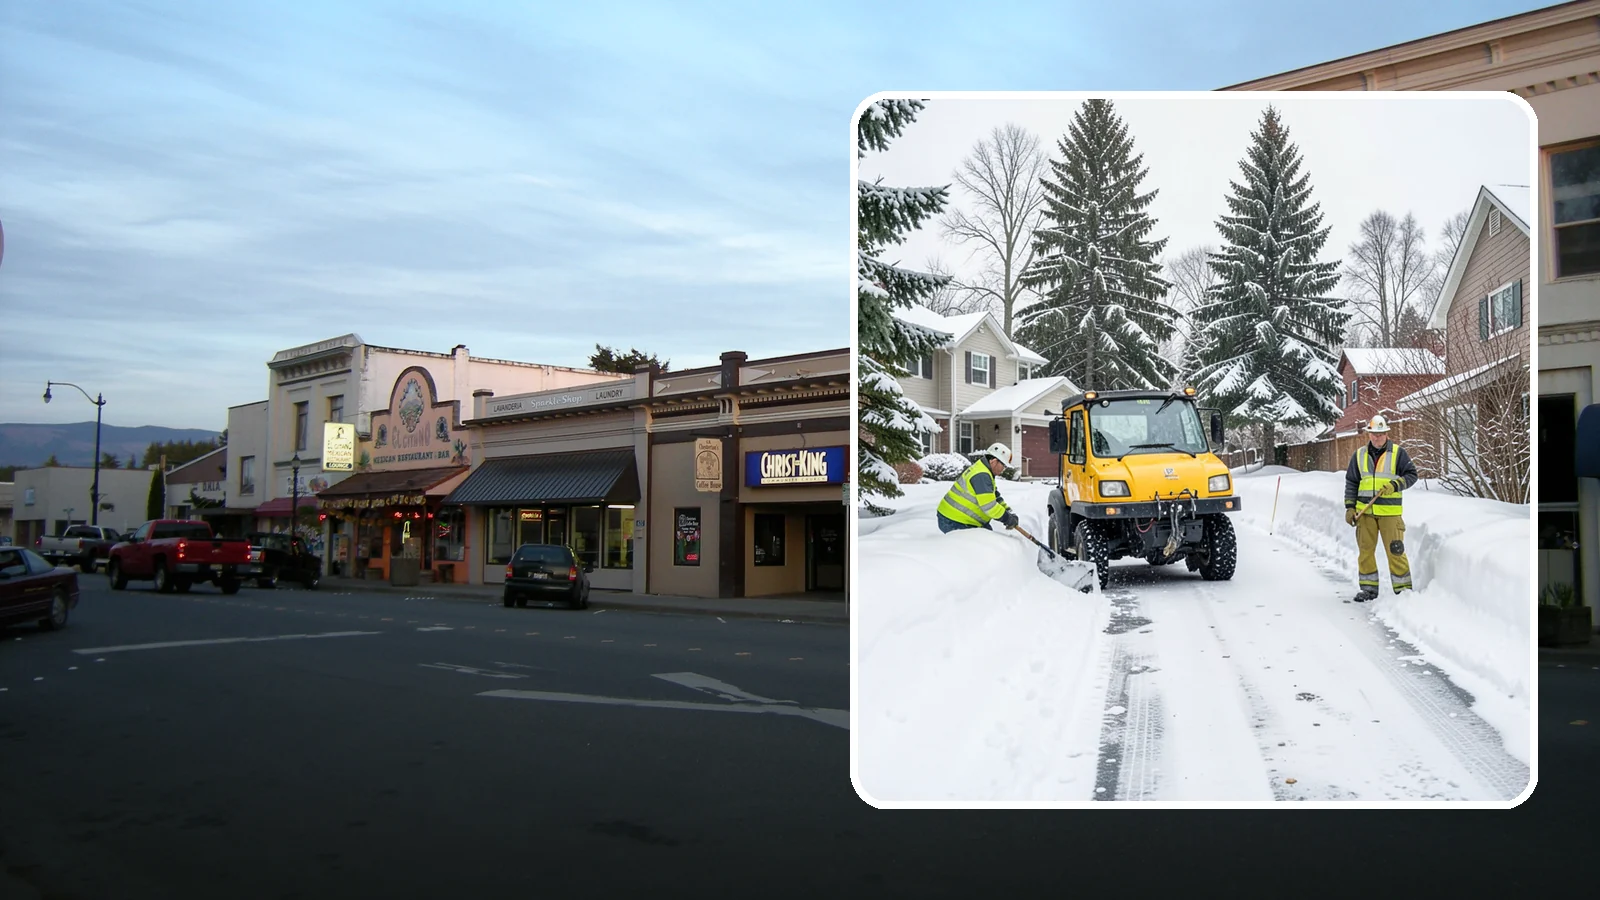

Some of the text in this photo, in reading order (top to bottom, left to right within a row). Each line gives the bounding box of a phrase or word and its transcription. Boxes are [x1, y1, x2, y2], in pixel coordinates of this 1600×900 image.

[595, 388, 624, 400] LAUNDRY
[493, 401, 523, 413] LAVANDERIA
[530, 394, 583, 409] Sparkle Shop
[373, 454, 396, 464] MEXICAN
[397, 451, 434, 462] RESTAURANT
[438, 450, 450, 459] BAR
[761, 450, 827, 478] CHRIST KING
